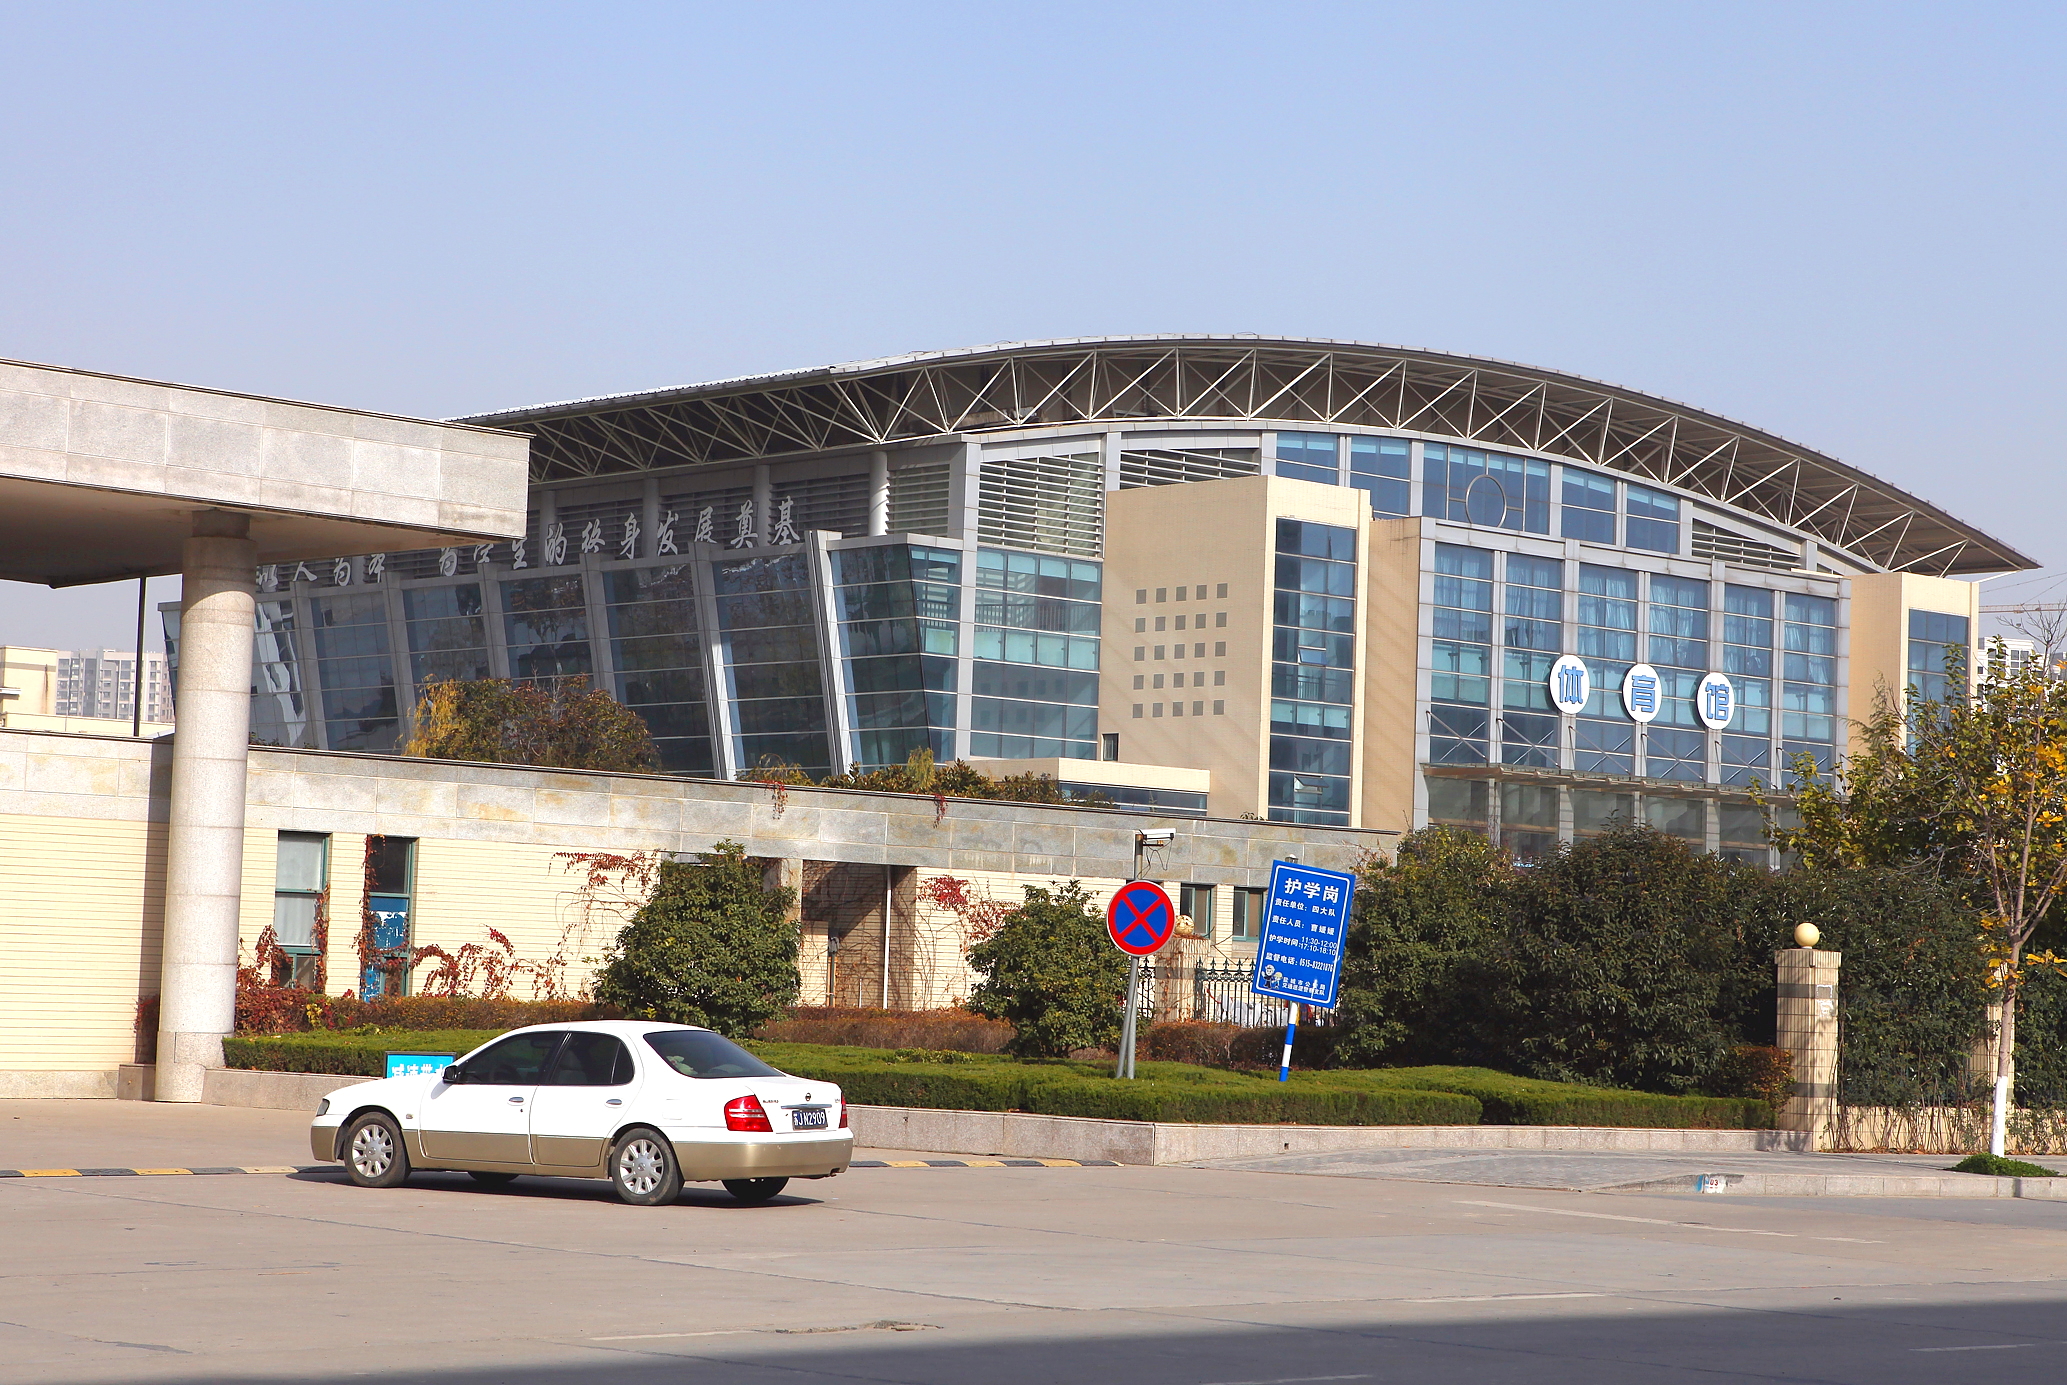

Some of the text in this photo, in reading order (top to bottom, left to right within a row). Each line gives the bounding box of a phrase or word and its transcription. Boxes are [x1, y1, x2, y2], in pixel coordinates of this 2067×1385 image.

[1557, 664, 1730, 721] 体育馆
[1284, 877, 1340, 904] 护学岗
[1311, 905, 1336, 917] 四大队
[1301, 936, 1338, 949] 11:30-12:00
